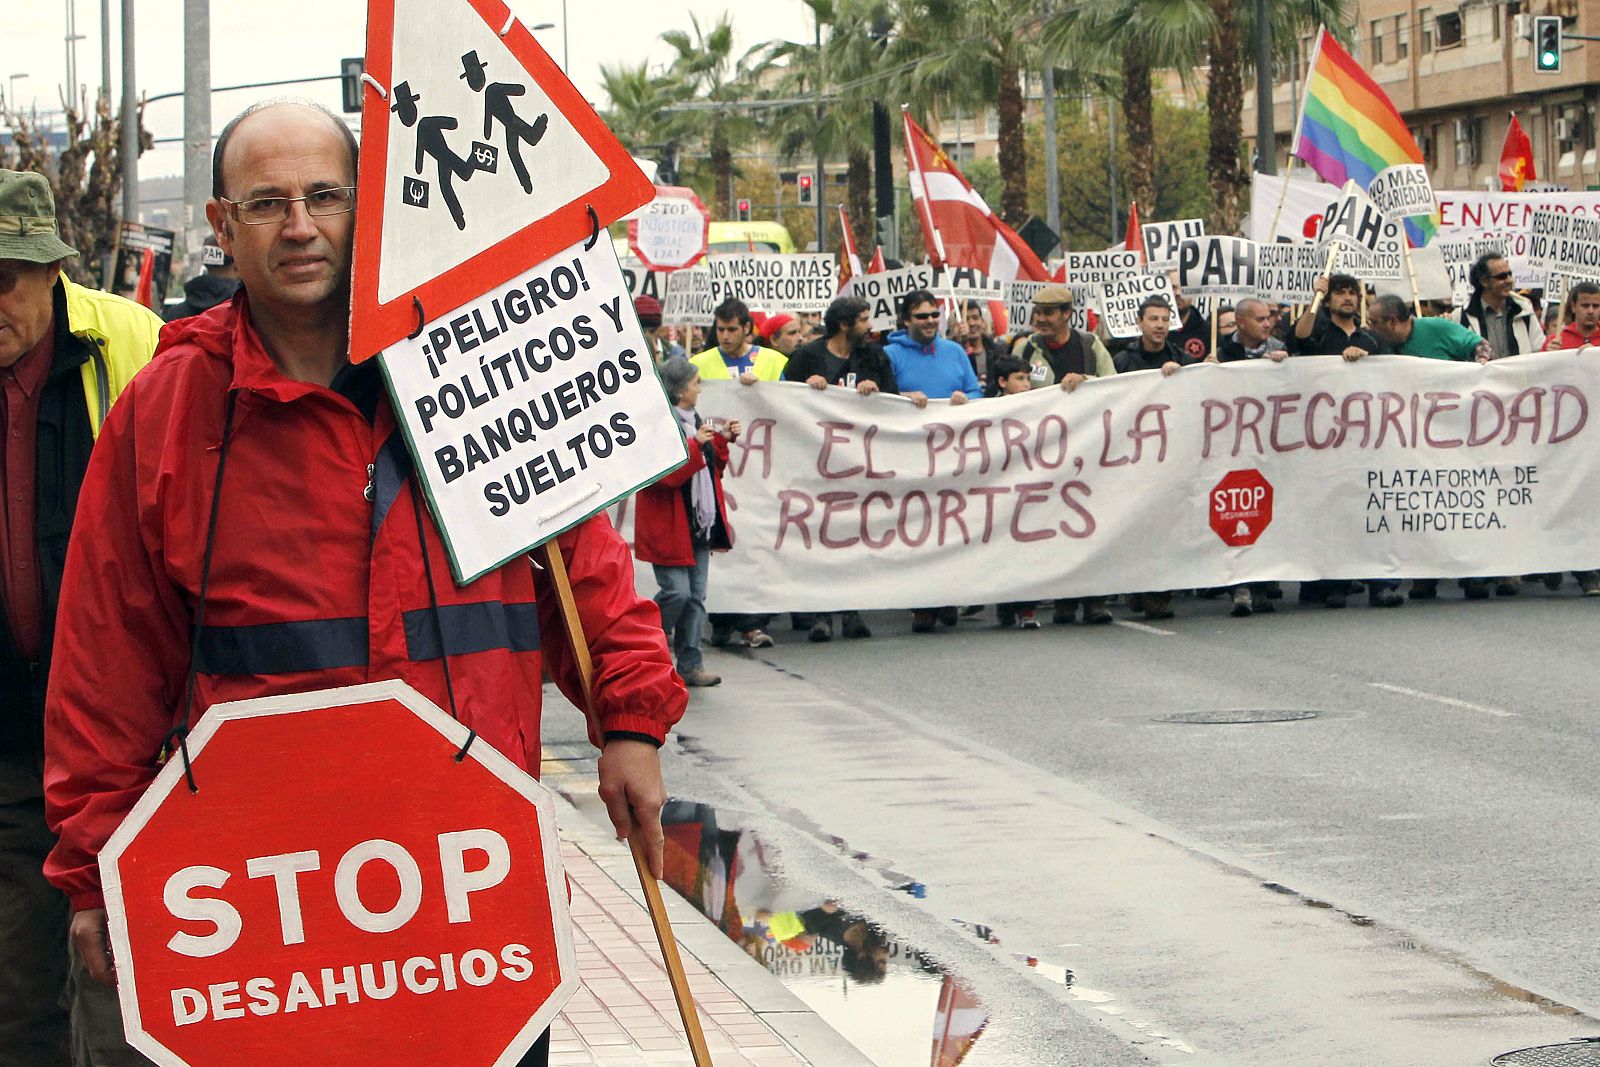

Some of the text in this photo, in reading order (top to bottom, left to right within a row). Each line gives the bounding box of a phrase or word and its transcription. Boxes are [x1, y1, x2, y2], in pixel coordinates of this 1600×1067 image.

[1388, 166, 1427, 188] MÁS
[650, 203, 689, 215] STOP
[1375, 185, 1431, 214] ECARIEDAD
[1319, 196, 1383, 251] PAH
[1533, 212, 1600, 243] RESCATAR PERSON
[203, 248, 222, 258] PAH
[1259, 246, 1293, 267] RESCATAR
[1297, 247, 1330, 268] PERSONA
[1530, 235, 1547, 258] NO
[1549, 240, 1557, 259] A
[709, 256, 755, 279] NO MÁS
[756, 256, 832, 277] NO MÁS
[1070, 254, 1136, 269] BANCO
[1180, 238, 1255, 287] PAH
[711, 279, 756, 301] PARO
[757, 279, 832, 300] RECORTES
[853, 270, 929, 298] NO MÁS
[1104, 275, 1167, 298] BANCO
[1258, 269, 1318, 292] NO A BANC
[684, 292, 713, 314] BANCO
[1010, 305, 1026, 325] NO
[421, 258, 590, 379] ¡PELIGRO!
[414, 296, 625, 433] POLÍTICOS Y
[434, 349, 642, 484] BANQUEROS
[818, 421, 896, 480] EL
[922, 414, 1084, 477] PARO,
[1100, 403, 1170, 467] LA
[1201, 384, 1589, 459] PRECARIEDAD
[483, 412, 637, 517] SUELTOS
[1367, 466, 1539, 489] PLATAFORMA DE
[1214, 486, 1266, 512] STOP
[1367, 487, 1534, 511] AFECTADOS POR
[774, 480, 1097, 550] RECORTES
[1366, 511, 1507, 534] LA HIPOTECA.
[162, 828, 512, 959] STOP
[170, 943, 535, 1028] DESAHUCIOS
